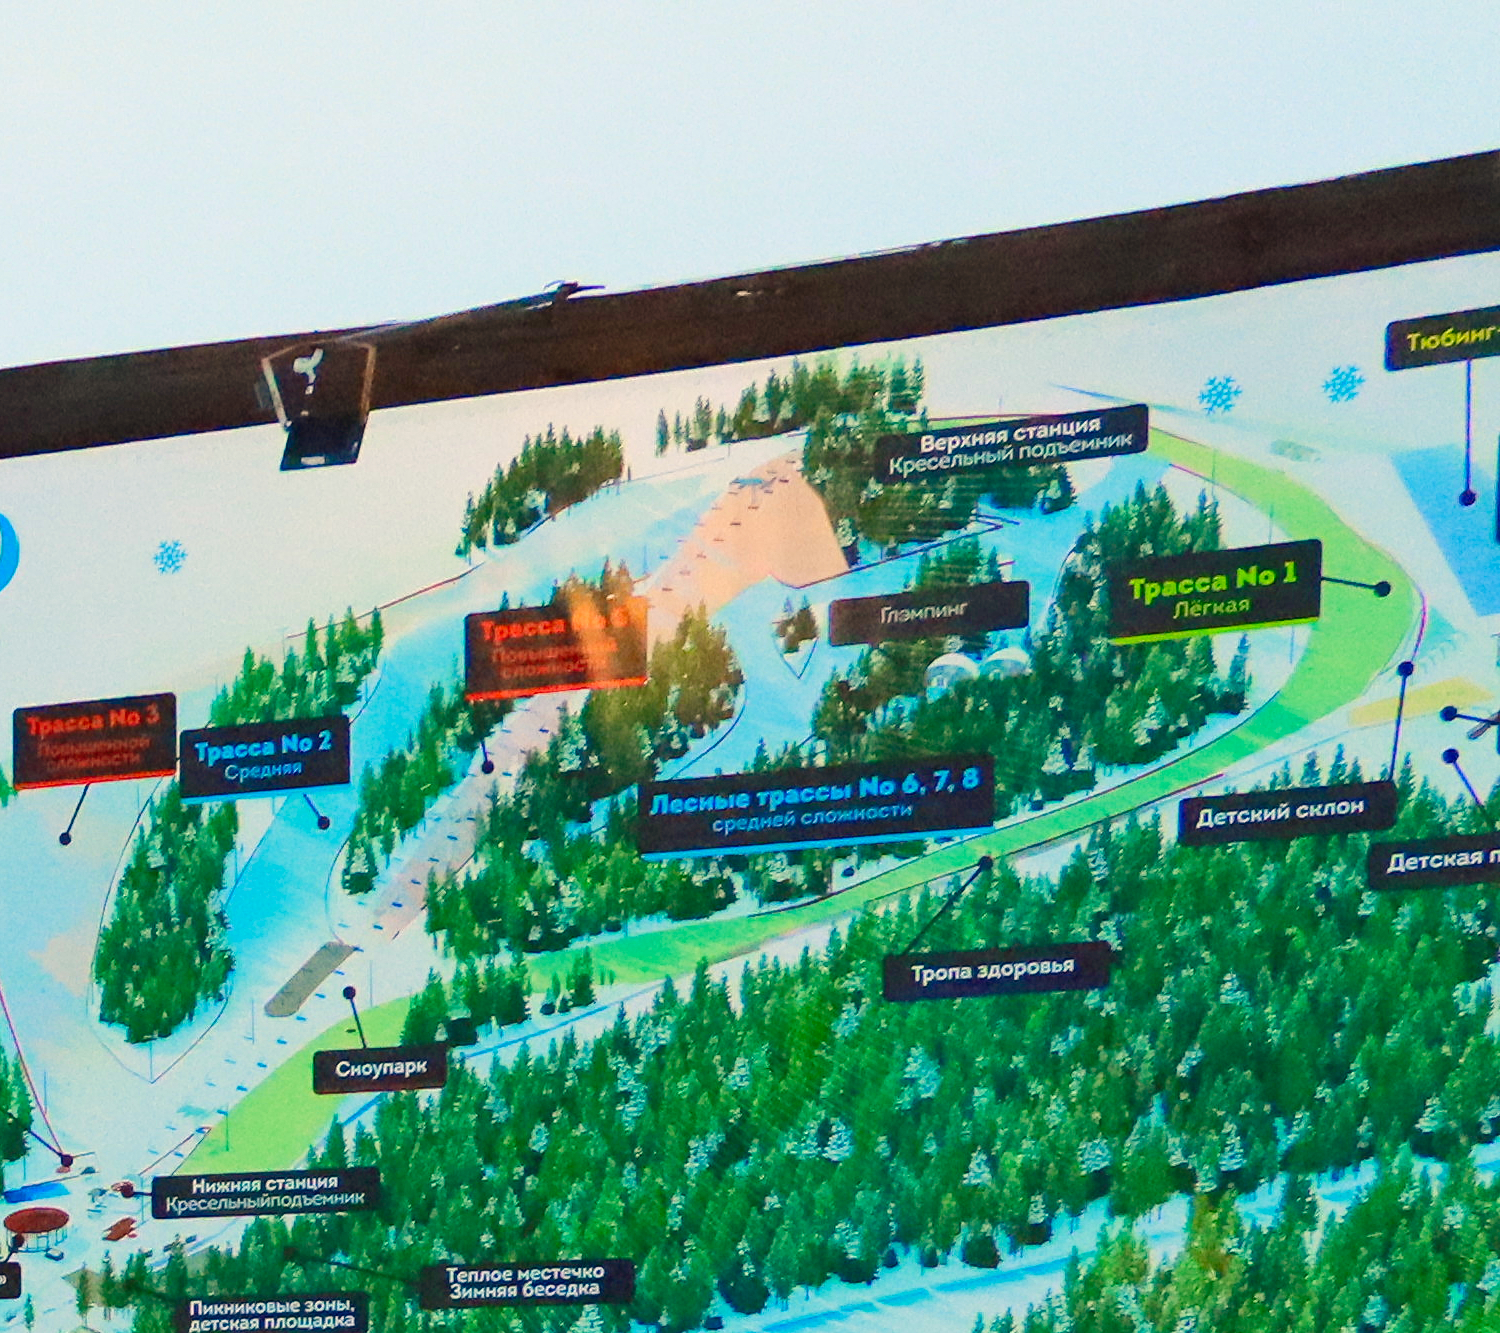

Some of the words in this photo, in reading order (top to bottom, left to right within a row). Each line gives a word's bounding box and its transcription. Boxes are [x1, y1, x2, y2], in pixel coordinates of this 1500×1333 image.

[920, 425, 1008, 456] Верхняя
[1013, 416, 1101, 442] станция
[889, 443, 1014, 478] Кресельный
[1019, 433, 1133, 464] подъемник
[1129, 576, 1227, 607] Трасса
[1282, 561, 1297, 583] 1
[880, 601, 968, 627] Глэмпинг
[1172, 598, 1251, 620] Лёгкая
[480, 618, 567, 643] Трасса
[27, 714, 104, 740] Трасса
[146, 703, 160, 723] 3
[195, 740, 275, 767] Трасса
[318, 729, 332, 751] 2
[224, 761, 302, 782] Средняя
[650, 791, 750, 816] Лесные
[756, 782, 851, 812] трассы
[901, 770, 926, 796] 6,
[933, 769, 955, 793] 7,
[962, 767, 979, 790] 8
[713, 811, 795, 836] средней
[800, 803, 913, 826] сложности
[1196, 802, 1290, 829] Детский
[1295, 800, 1365, 819] склон
[1386, 849, 1484, 875] Детская
[911, 965, 972, 986] Тропа
[977, 958, 1075, 980] здоровья
[335, 1060, 427, 1080] Сноупарк
[192, 1178, 261, 1194] Нижняя
[265, 1175, 339, 1191] станция
[446, 1267, 513, 1284] Теплое
[517, 1265, 605, 1281] местечко
[450, 1283, 517, 1300] Зимняя
[522, 1280, 601, 1298] беседка
[189, 1299, 301, 1316] Пикниковые
[304, 1299, 355, 1313] зоны,
[188, 1316, 260, 1333] детская
[264, 1314, 356, 1331] площадка
